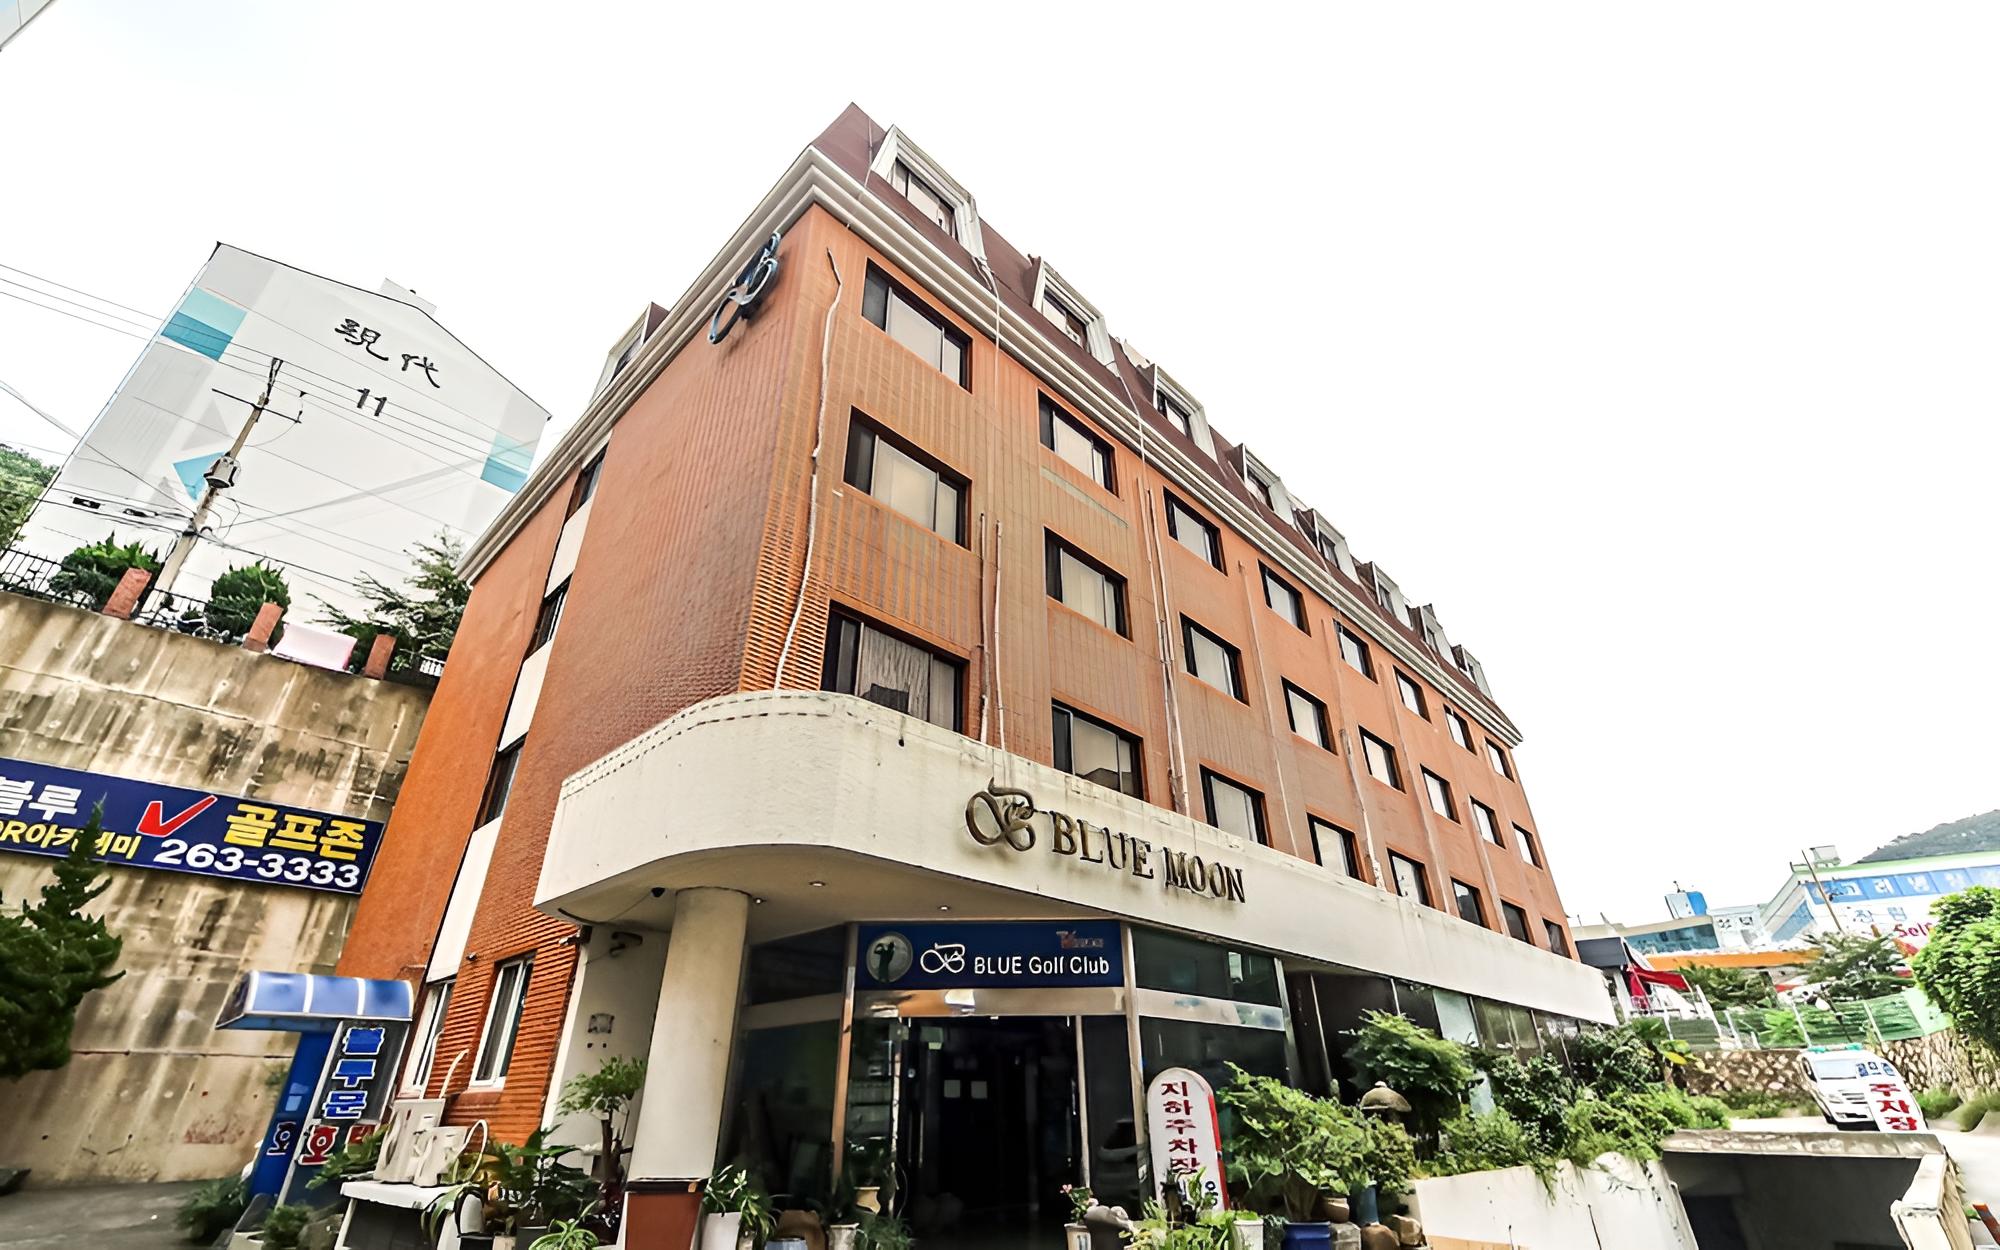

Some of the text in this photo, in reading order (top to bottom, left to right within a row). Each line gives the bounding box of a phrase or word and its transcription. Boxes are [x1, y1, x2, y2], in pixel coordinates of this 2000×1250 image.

[357, 388, 388, 417] 11
[223, 803, 366, 861] 골프존
[1049, 810, 1154, 879] BLUE
[1162, 846, 1246, 903] MOON
[153, 838, 361, 888] 263-3333
[974, 956, 1022, 975] BLUE
[1029, 955, 1065, 975] Golf
[1069, 955, 1110, 975] Club
[1160, 1081, 1201, 1175] 지하주차장
